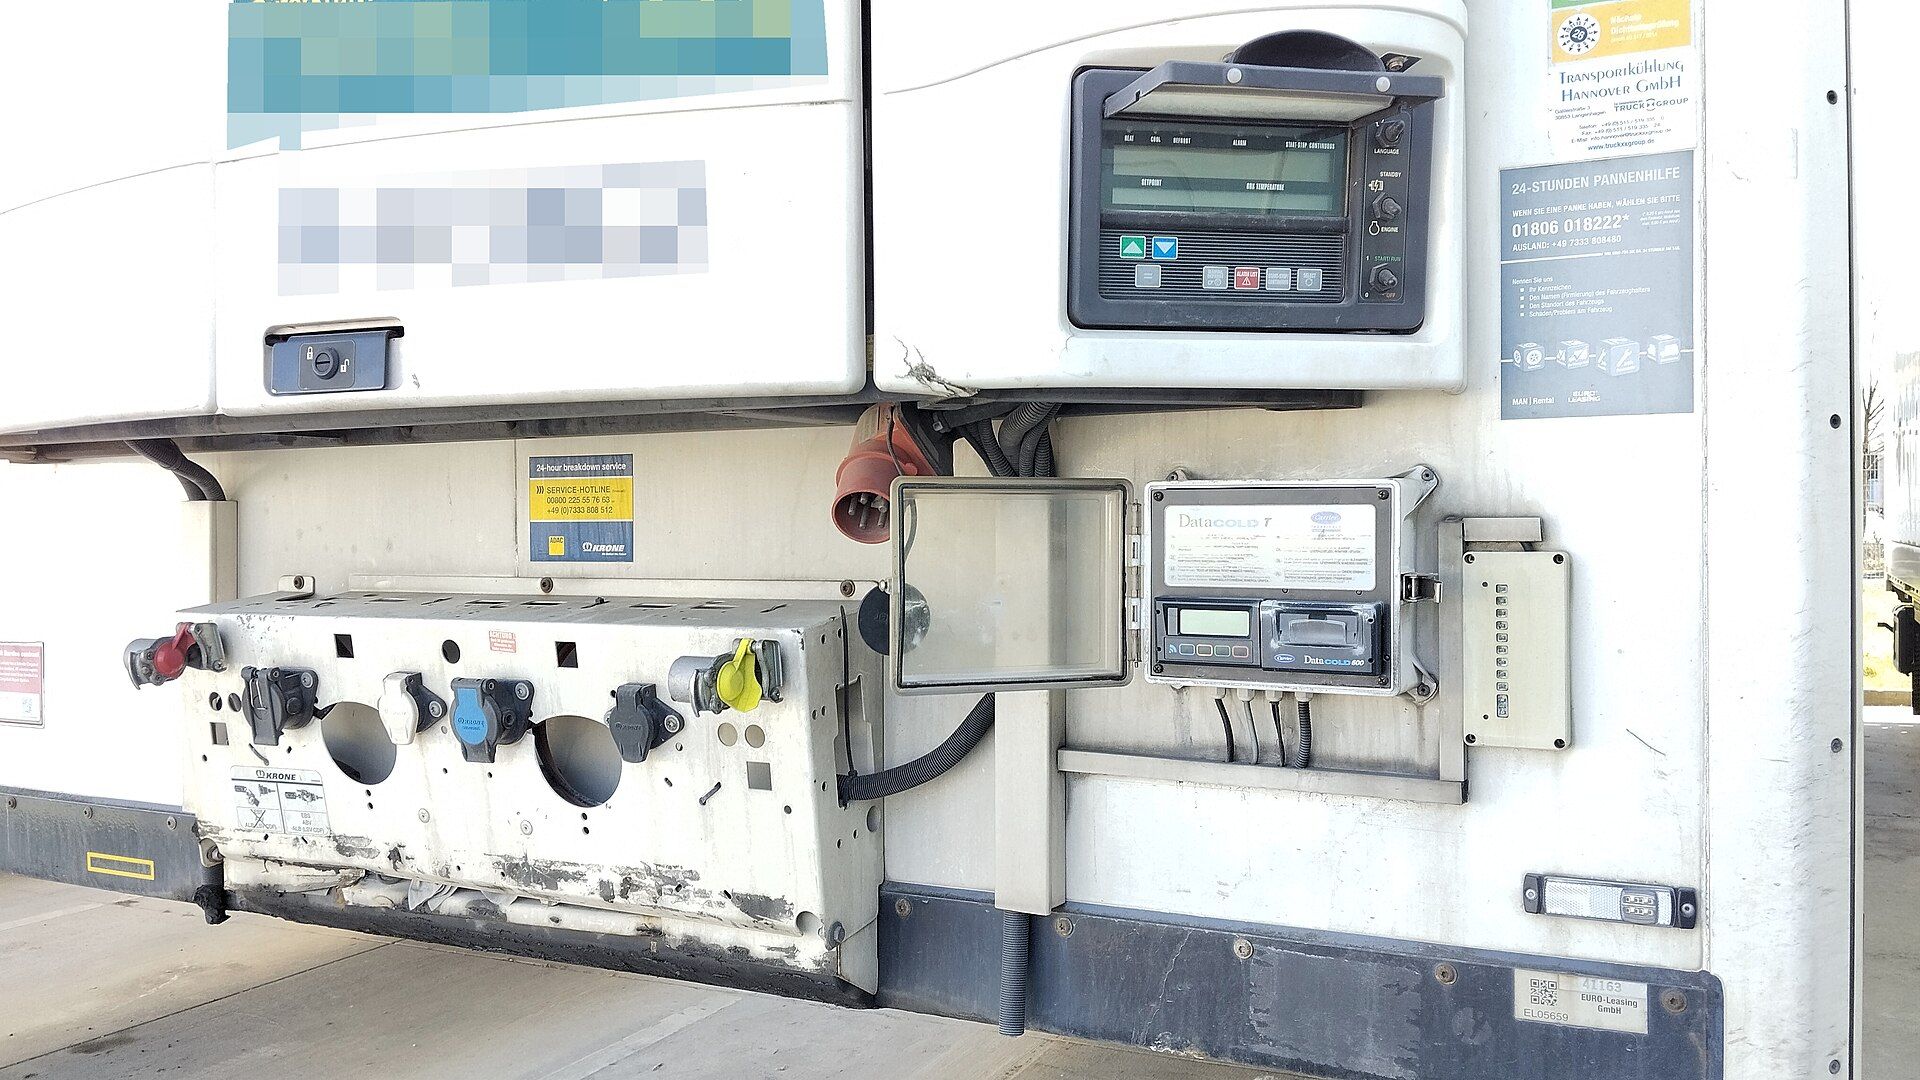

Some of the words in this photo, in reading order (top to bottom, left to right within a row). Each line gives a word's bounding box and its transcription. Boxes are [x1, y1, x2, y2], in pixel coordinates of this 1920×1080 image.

[1512, 175, 1589, 195] 24-STUNDEN
[1594, 166, 1680, 187] PANNENHILFE
[1513, 208, 1532, 218] WENN
[1534, 207, 1545, 216] SIE
[1546, 205, 1562, 215] EINE
[1647, 197, 1659, 205] SIE
[1513, 220, 1559, 238] 01806
[1513, 241, 1549, 252] AUSLAND:
[1552, 238, 1566, 249] +49
[1513, 397, 1528, 406] MAN
[537, 463, 562, 472] 24-hour
[564, 463, 600, 472] breakdown
[602, 462, 626, 470] service
[547, 486, 610, 494] SERVICE-HOTLINE
[592, 496, 600, 504] 76
[601, 496, 610, 504] 63
[547, 506, 559, 514] +49
[587, 506, 599, 514] 808
[600, 506, 613, 514] 512
[266, 773, 296, 781] KRONE
[1583, 978, 1622, 993] 41163
[1581, 993, 1638, 1009] EURO-Leasing
[1524, 1008, 1569, 1022] EL05659
[1598, 1005, 1622, 1015] GmbH
